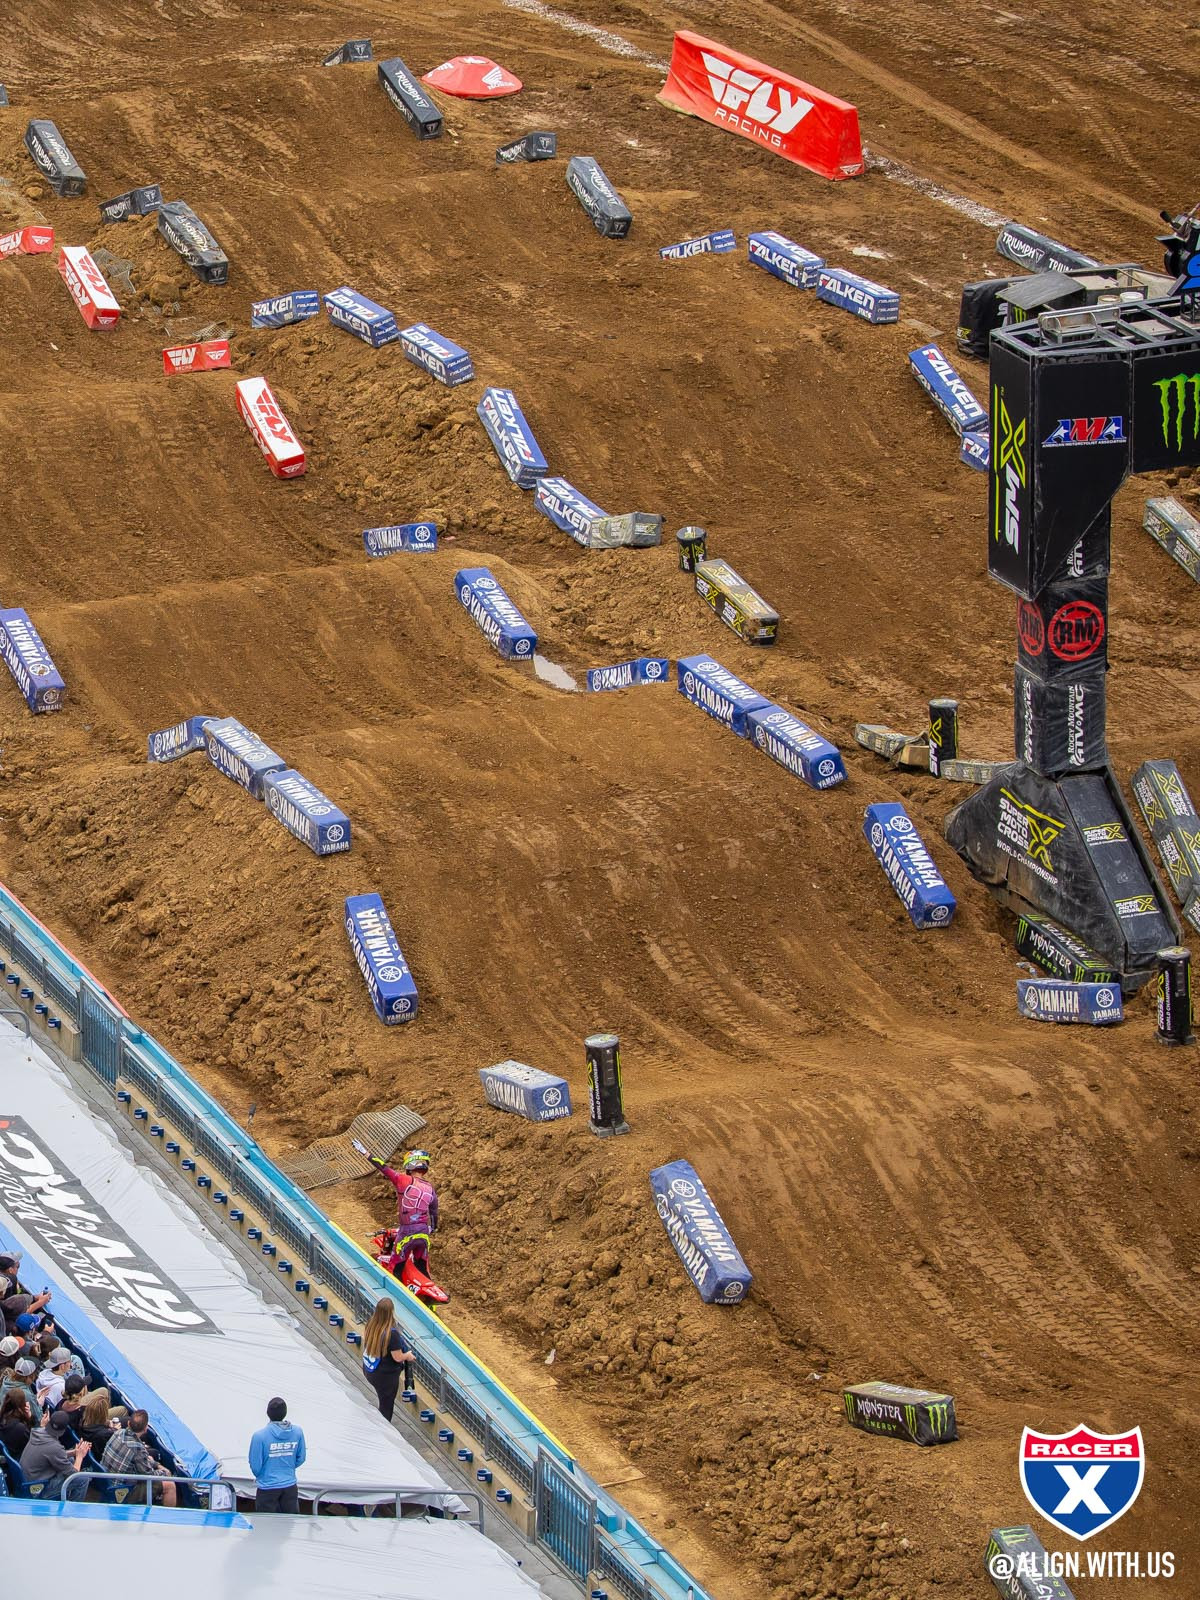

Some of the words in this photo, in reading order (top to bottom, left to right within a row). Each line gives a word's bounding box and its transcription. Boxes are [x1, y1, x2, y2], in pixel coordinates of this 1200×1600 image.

[394, 69, 422, 104] TRIUMPH
[700, 51, 815, 134] FLY
[714, 109, 782, 146] RACING
[589, 166, 613, 201] TRIUMPH
[661, 239, 711, 260] FALKEN
[749, 240, 800, 278] FALKEN
[1001, 231, 1036, 260] TRIUMPH
[77, 255, 113, 298] FLY
[819, 275, 874, 309] FALKEN
[254, 295, 292, 317] FALKEN
[326, 291, 379, 319] FALKEN
[326, 301, 371, 336] FALKEN
[167, 347, 197, 367] FLY
[400, 329, 452, 358] FALKEN
[402, 341, 446, 376] FALKEN
[923, 349, 985, 418] FALKEN
[256, 388, 294, 444] FLY
[492, 389, 535, 463] FALKEN
[950, 403, 968, 421] TIRES
[483, 396, 522, 473] FALKEN
[1041, 416, 1127, 444] AMA
[537, 486, 591, 536] FALKEN
[375, 528, 402, 549] YAMAHA
[469, 594, 502, 646] YAMAHA
[486, 589, 526, 627] YAMAHA
[5, 618, 43, 664] YAMAHA
[1055, 617, 1096, 644] RM
[5, 638, 30, 695] YAMAHA
[601, 663, 632, 688] YAMAHA
[694, 680, 735, 724] YAMAHA
[709, 670, 760, 700] YAMAHA
[162, 722, 188, 745] YAMAHA
[217, 725, 252, 761] YAMAHA
[762, 720, 802, 752] RACING
[777, 716, 824, 752] YAMAHA
[217, 743, 250, 787] YAMAHA
[765, 734, 805, 779] YAMAHA
[276, 777, 318, 808] YAMAHA
[817, 771, 843, 789] YAMAHA
[277, 796, 311, 840] YAMAHA
[999, 797, 1028, 829] SUPER
[1000, 811, 1028, 839] MOTO
[322, 841, 349, 852] YAMAHA
[998, 822, 1030, 850] CROSS
[1027, 815, 1059, 872] X
[880, 836, 917, 909] YAMAHA
[899, 831, 945, 889] YAMAHA
[997, 840, 1016, 858] WORLD
[1017, 853, 1058, 885] CHAMPIONSHIP
[356, 907, 396, 966] YAMAHA
[380, 911, 410, 974] RACING
[1029, 929, 1072, 974] MONSTER
[350, 931, 378, 1002] YAMAHA
[386, 1012, 415, 1022] YAMAHA
[1031, 1012, 1078, 1022] RACING
[1038, 988, 1080, 1014] YAMAHA
[1092, 1008, 1121, 1020] YAMAHA
[494, 1082, 527, 1112] YAMAHA
[539, 1105, 569, 1119] YAMAHA
[668, 1190, 714, 1258] RACING
[682, 1198, 737, 1264] YAMAHA
[34, 1220, 121, 1295] ROCKY
[667, 1211, 710, 1287] YAMAHA
[857, 1398, 902, 1423] MONSTER
[864, 1418, 898, 1432] ENERGY
[269, 1442, 298, 1450] BEST
